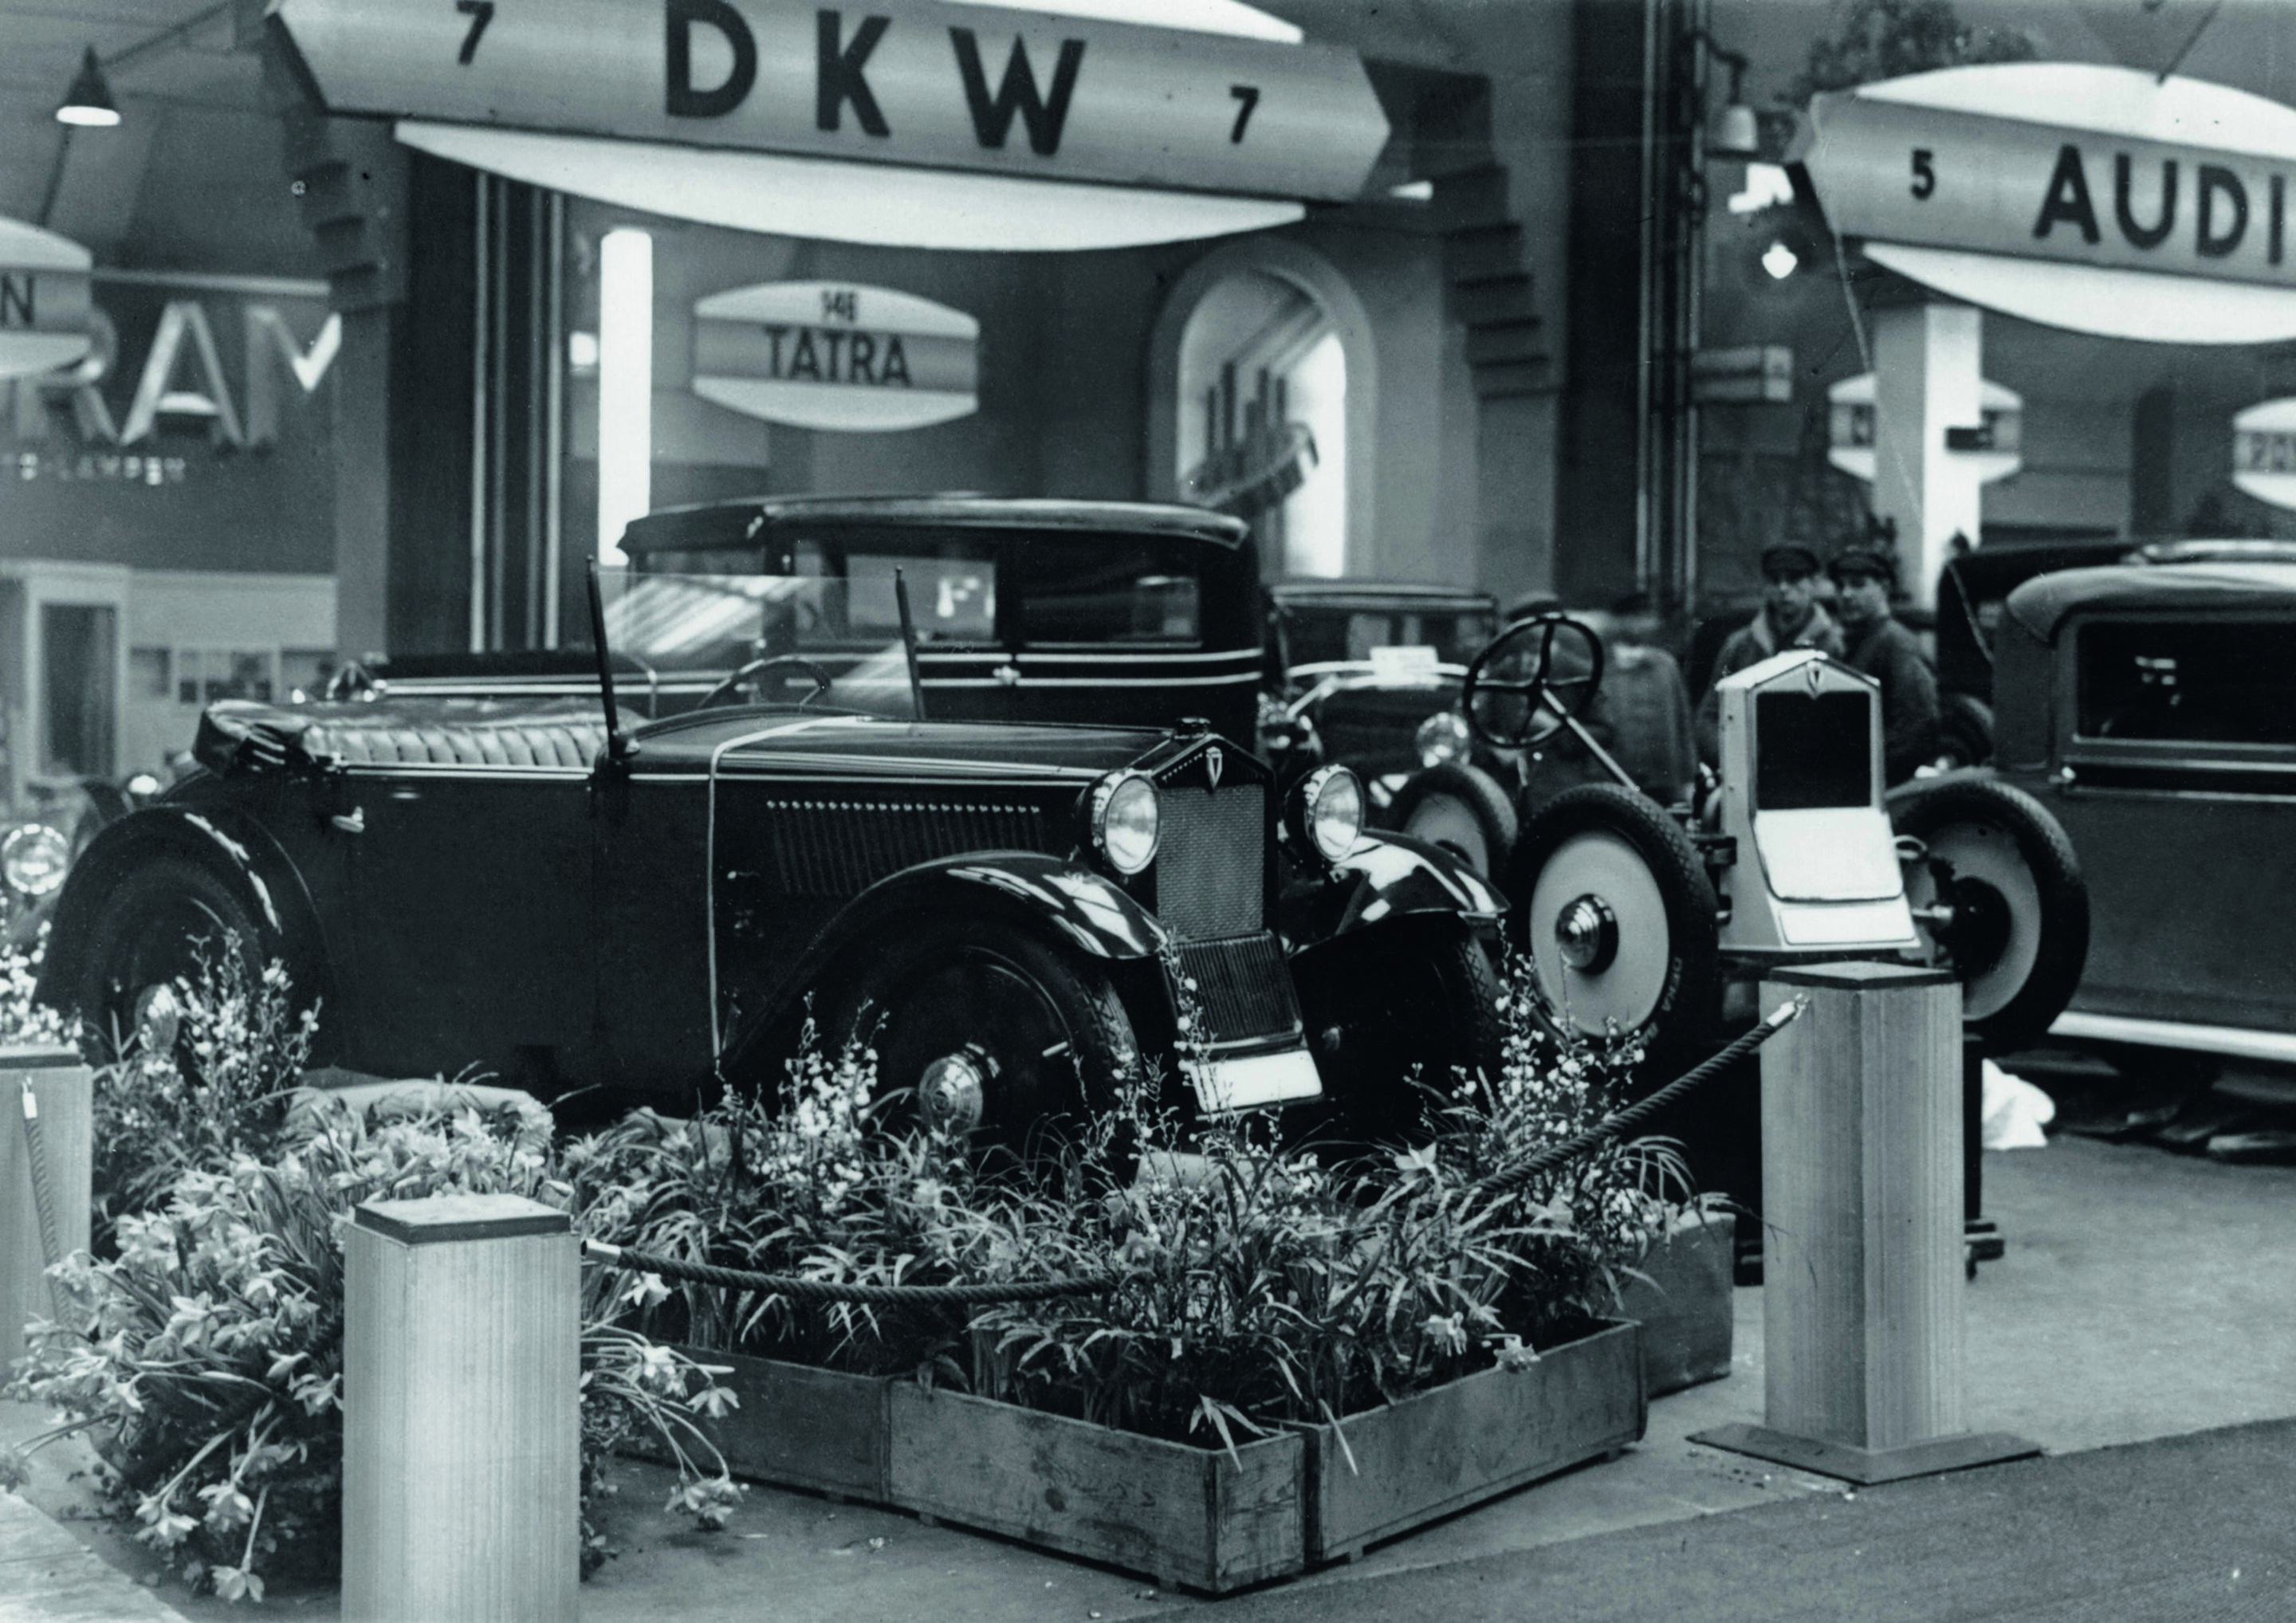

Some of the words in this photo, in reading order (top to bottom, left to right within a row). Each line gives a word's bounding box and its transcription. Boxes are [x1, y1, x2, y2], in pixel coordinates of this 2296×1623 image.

[457, 0, 494, 66] 7
[663, 0, 1088, 156] DKW
[1229, 84, 1260, 145] 7
[1909, 147, 1936, 202] 5
[2031, 143, 2286, 268] AUDI
[763, 324, 914, 387] TATRA
